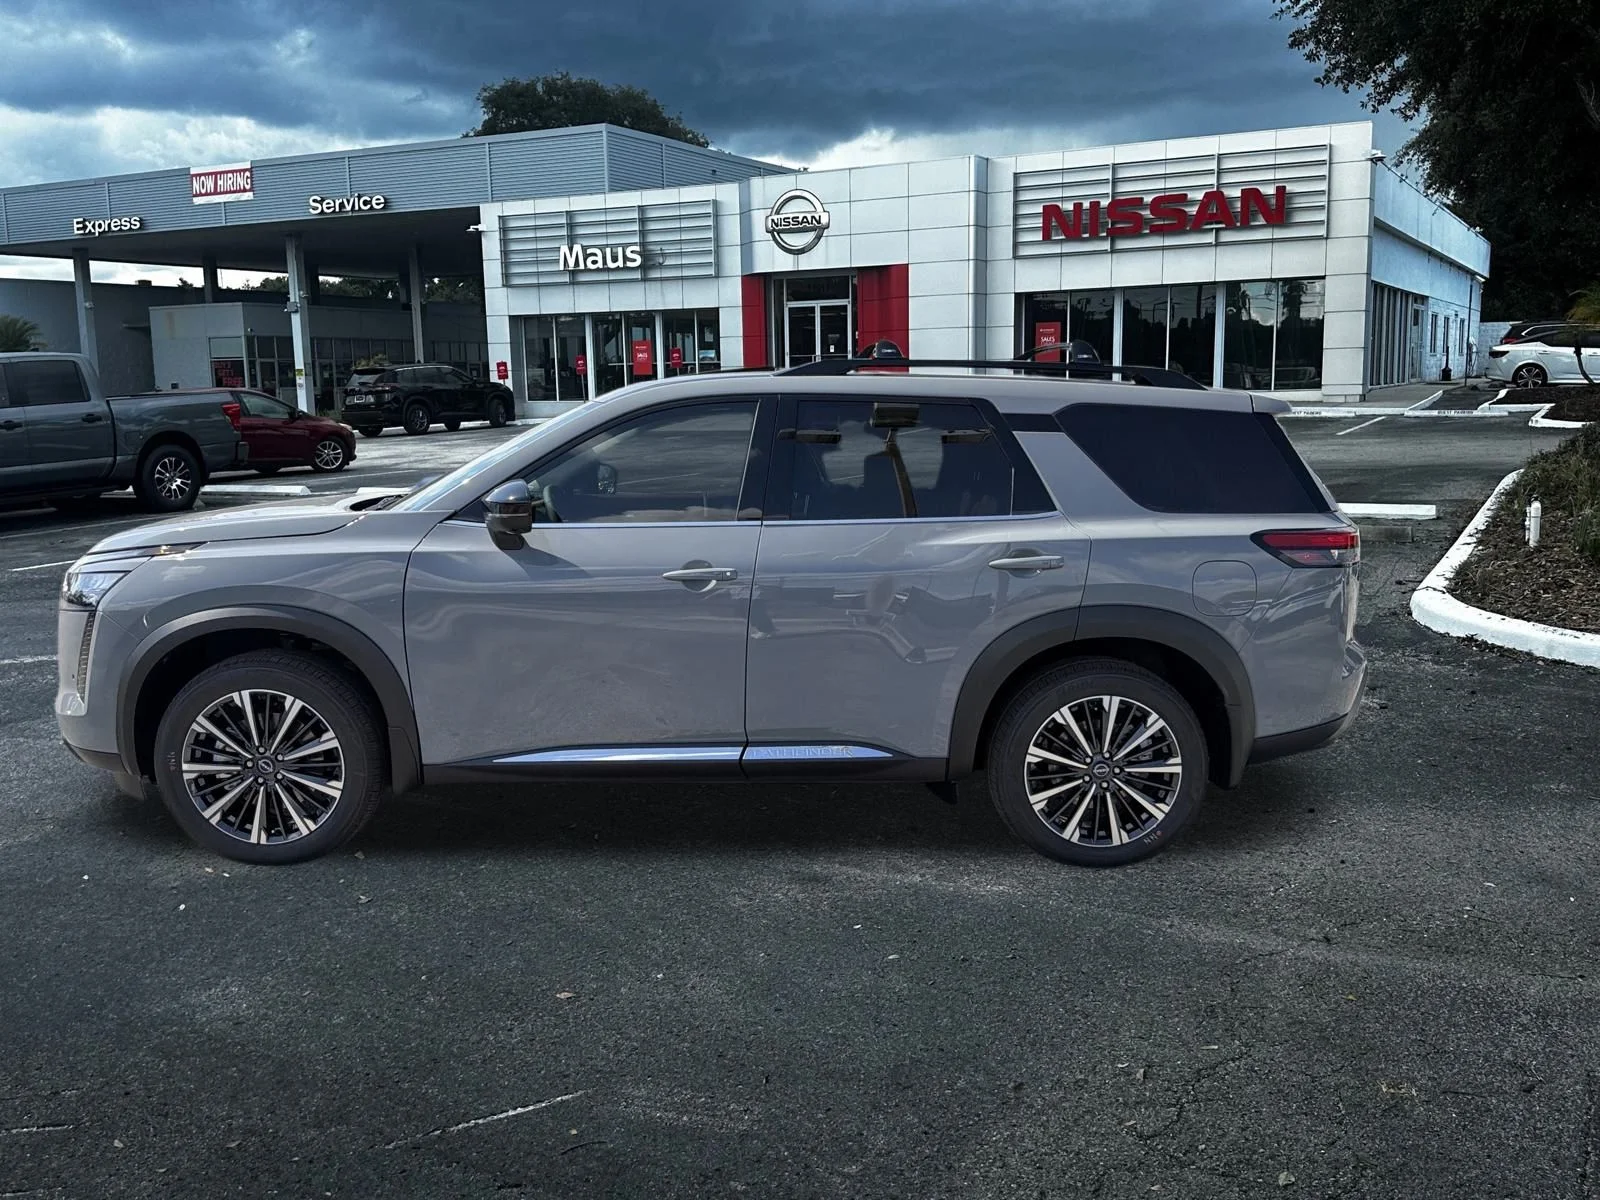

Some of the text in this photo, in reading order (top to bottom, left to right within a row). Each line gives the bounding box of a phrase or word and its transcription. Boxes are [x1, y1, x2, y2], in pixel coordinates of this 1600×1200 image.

[191, 170, 252, 195] NOW HIRING
[308, 193, 386, 215] Service
[1042, 185, 1286, 241] NISSAN
[73, 216, 141, 237] Express
[770, 215, 822, 228] NISSAN
[559, 243, 642, 271] Maus
[752, 746, 853, 758] PATHFINDER
